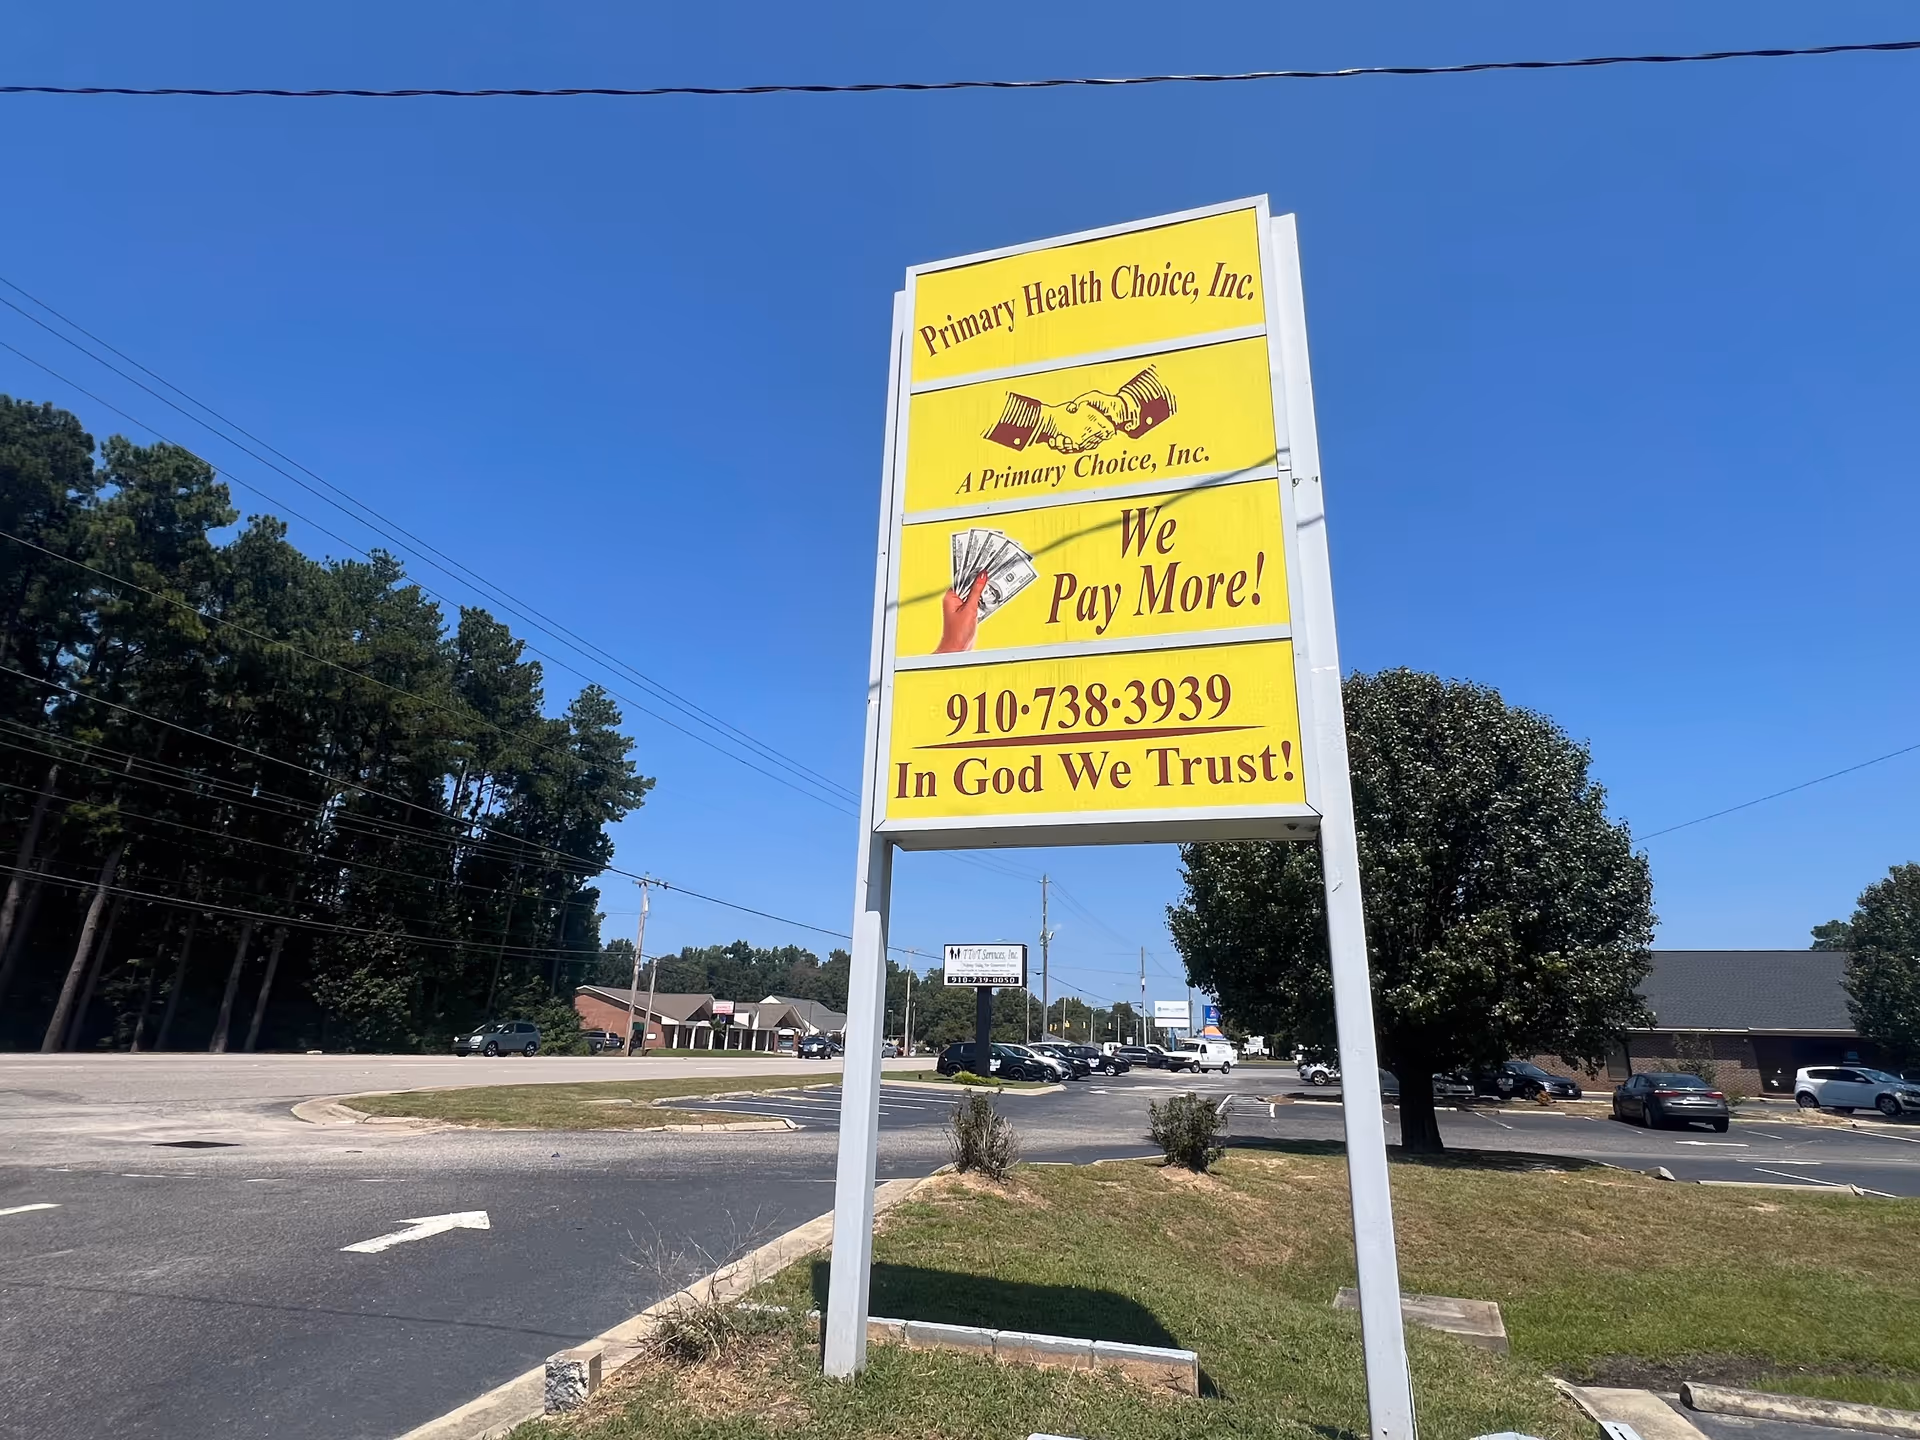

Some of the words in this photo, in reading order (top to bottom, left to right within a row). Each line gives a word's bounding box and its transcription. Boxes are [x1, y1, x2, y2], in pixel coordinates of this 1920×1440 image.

[919, 299, 1016, 357] Primary
[1023, 269, 1103, 318] Health
[1110, 261, 1199, 303] Choice,
[1207, 261, 1256, 301] Inc.
[956, 475, 974, 494] A
[978, 465, 1066, 491] Primary
[1073, 450, 1158, 478] Choice,
[1165, 442, 1211, 468] Inc.
[1120, 505, 1177, 558] We
[1046, 572, 1122, 635] Pay
[1133, 551, 1264, 617] More!
[895, 762, 937, 799] In
[953, 756, 1043, 797] God
[1056, 751, 1131, 793] We
[1146, 741, 1294, 788] Trust!
